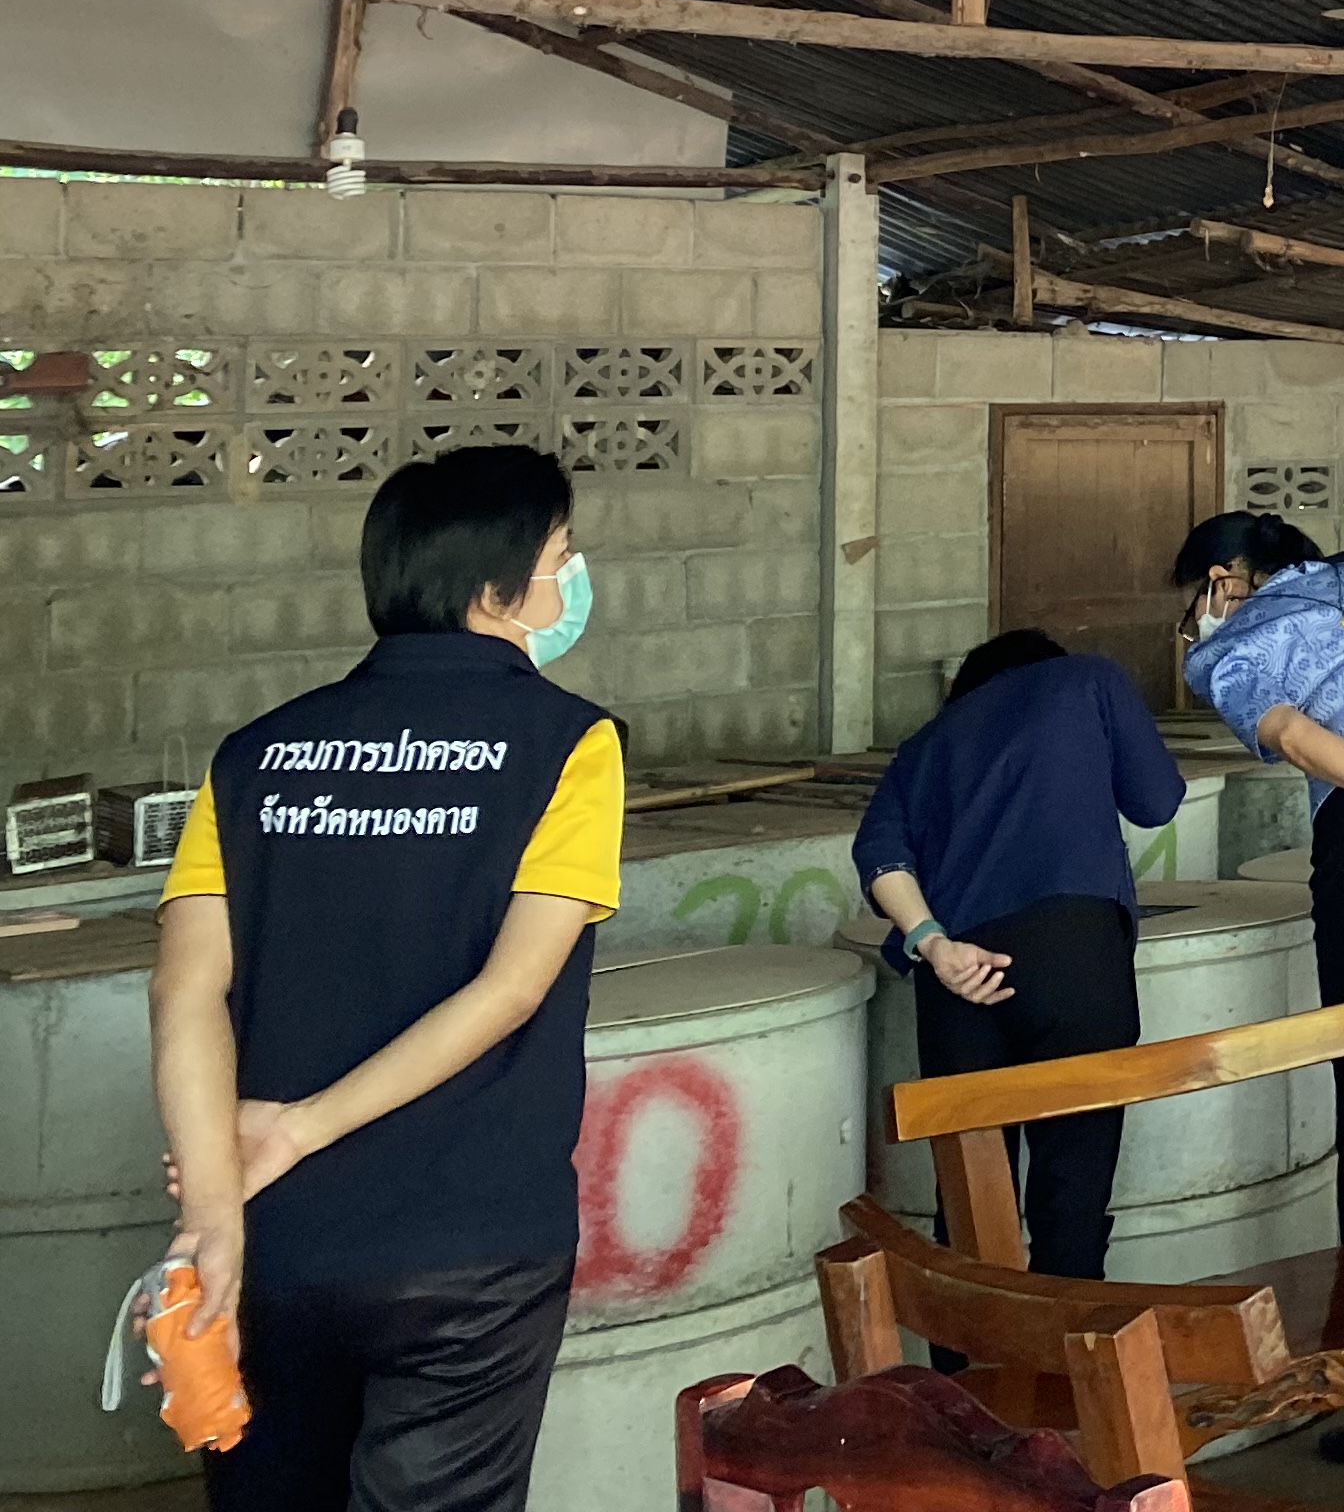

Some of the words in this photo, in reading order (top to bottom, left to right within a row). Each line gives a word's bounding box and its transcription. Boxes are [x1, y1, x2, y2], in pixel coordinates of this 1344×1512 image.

[258, 728, 508, 773] กรมการปกครอง
[258, 794, 480, 836] จังหวัดหนองคาย
